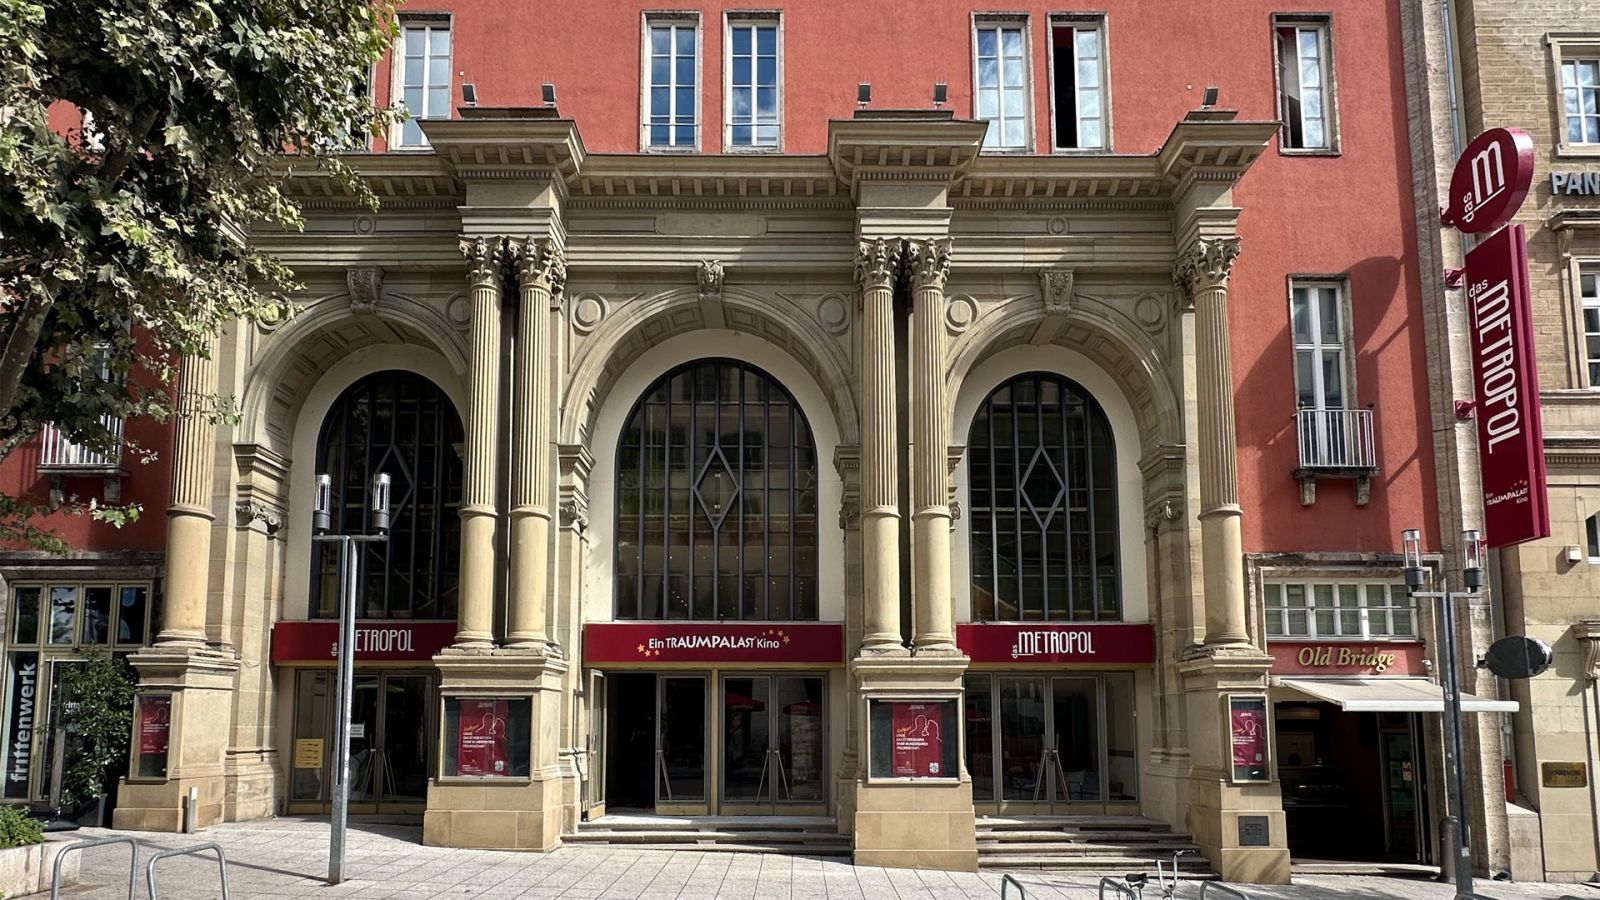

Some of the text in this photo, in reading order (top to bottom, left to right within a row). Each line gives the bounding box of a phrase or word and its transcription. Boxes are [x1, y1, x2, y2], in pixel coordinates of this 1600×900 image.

[1550, 171, 1600, 195] PAN
[1462, 191, 1475, 223] das
[1469, 279, 1488, 298] das
[330, 629, 415, 657] das ETROPOL
[649, 638, 664, 649] Ein
[756, 638, 780, 649] Kino
[1298, 646, 1396, 672] Old Bridge
[11, 662, 36, 783] frittenwerk
